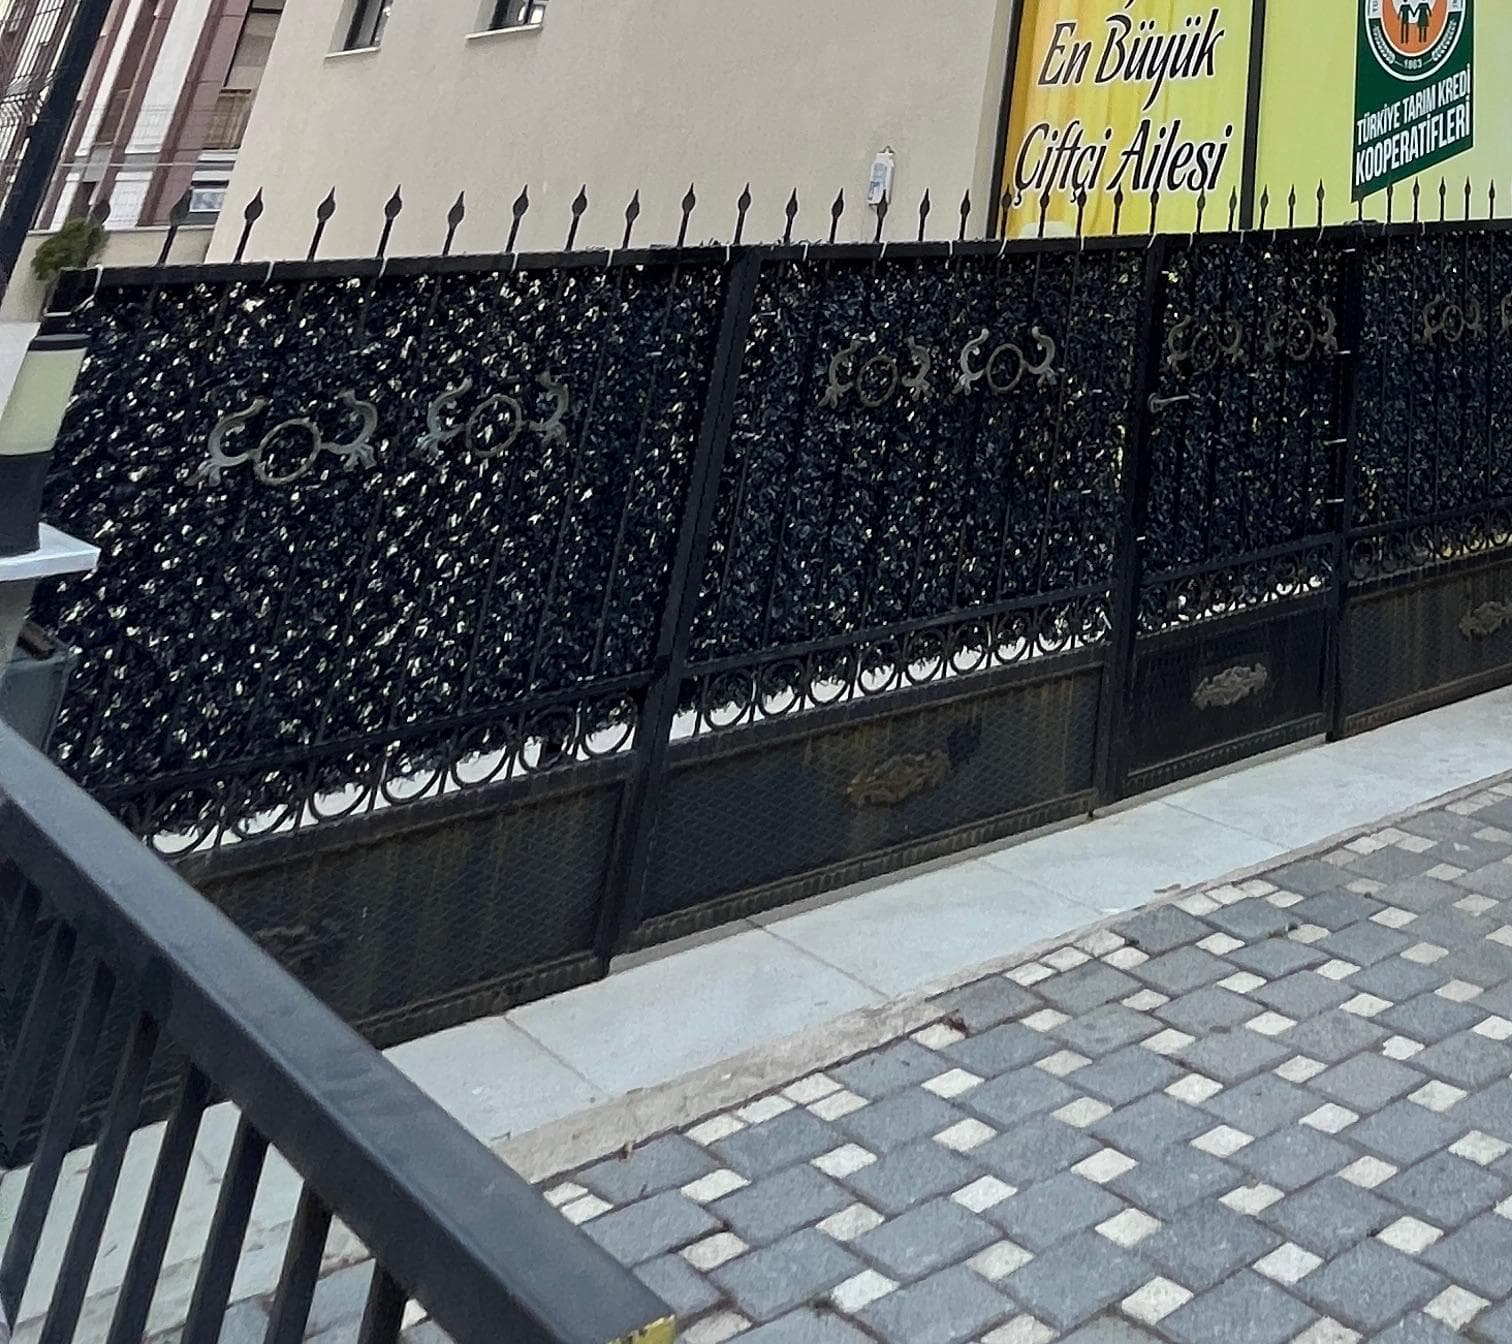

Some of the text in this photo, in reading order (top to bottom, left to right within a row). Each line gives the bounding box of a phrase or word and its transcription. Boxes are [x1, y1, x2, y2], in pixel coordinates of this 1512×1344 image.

[1037, 8, 1225, 111] En Büyük
[1355, 95, 1471, 187] KOOPERATİFLERİ
[1356, 63, 1471, 146] TÜRKİYE TARIM KREDİ
[1014, 119, 1232, 206] Çiftçi Ailesi
